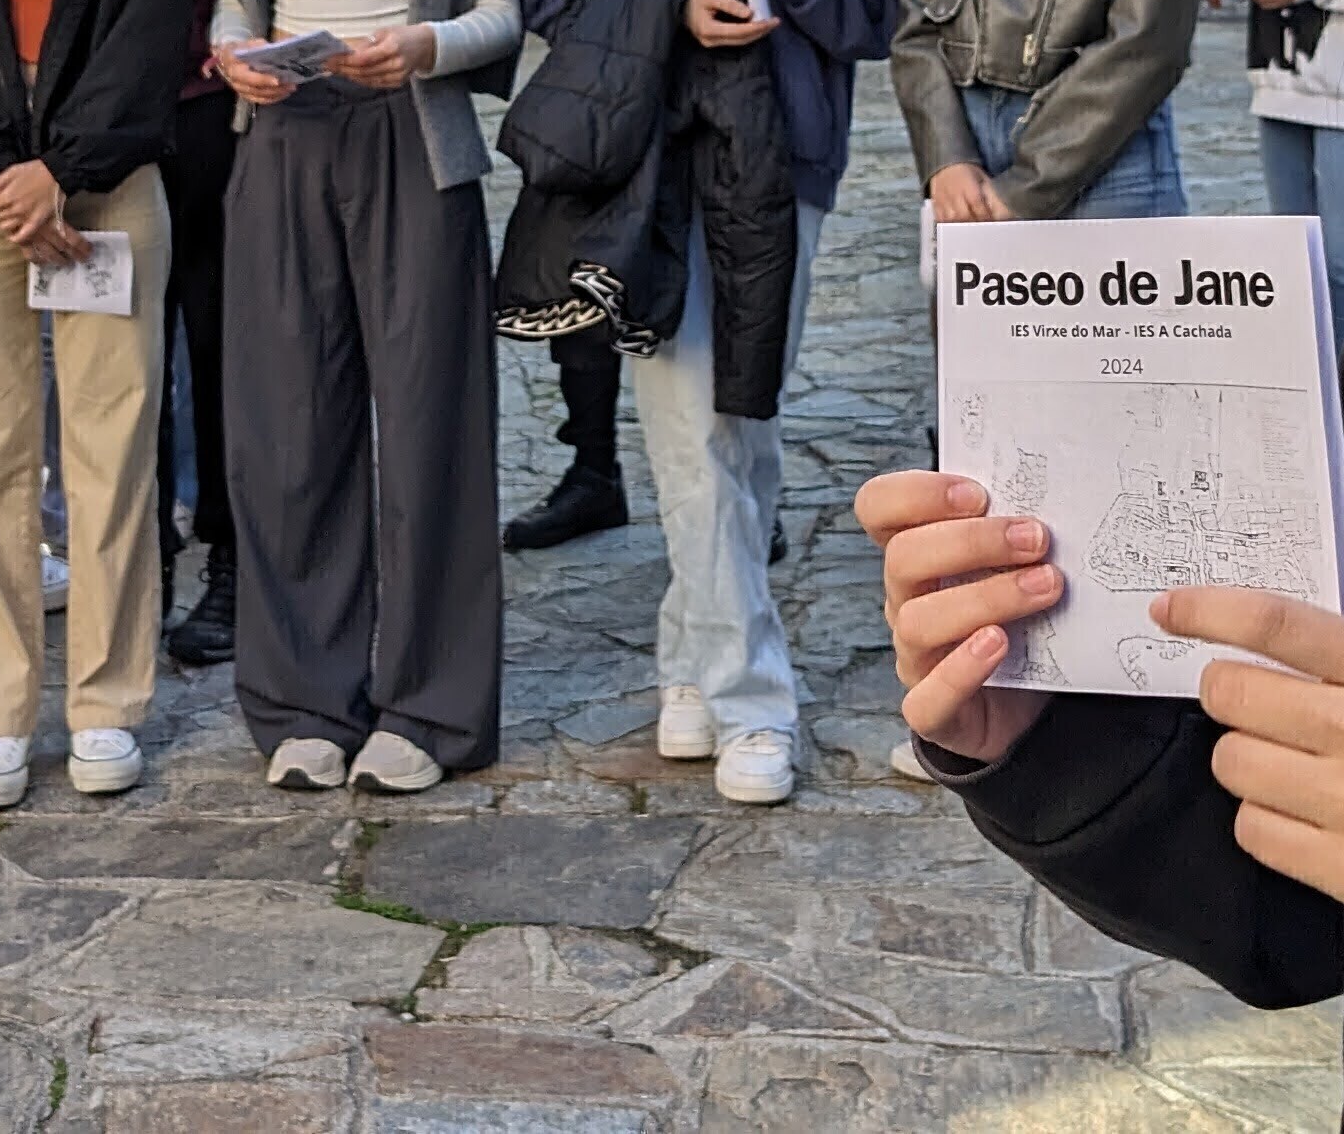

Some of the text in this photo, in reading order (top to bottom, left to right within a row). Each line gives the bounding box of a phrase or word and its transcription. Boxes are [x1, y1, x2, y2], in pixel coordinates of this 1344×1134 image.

[955, 259, 1275, 308] Paseo de Jane
[1010, 324, 1030, 337] IES
[1032, 324, 1068, 338] Virxe
[1071, 324, 1089, 338] do
[1092, 325, 1121, 338] Mar
[1133, 324, 1155, 338] IES
[1158, 324, 1170, 338] A
[1172, 324, 1233, 339] Cachada
[1100, 358, 1144, 375] 2024
